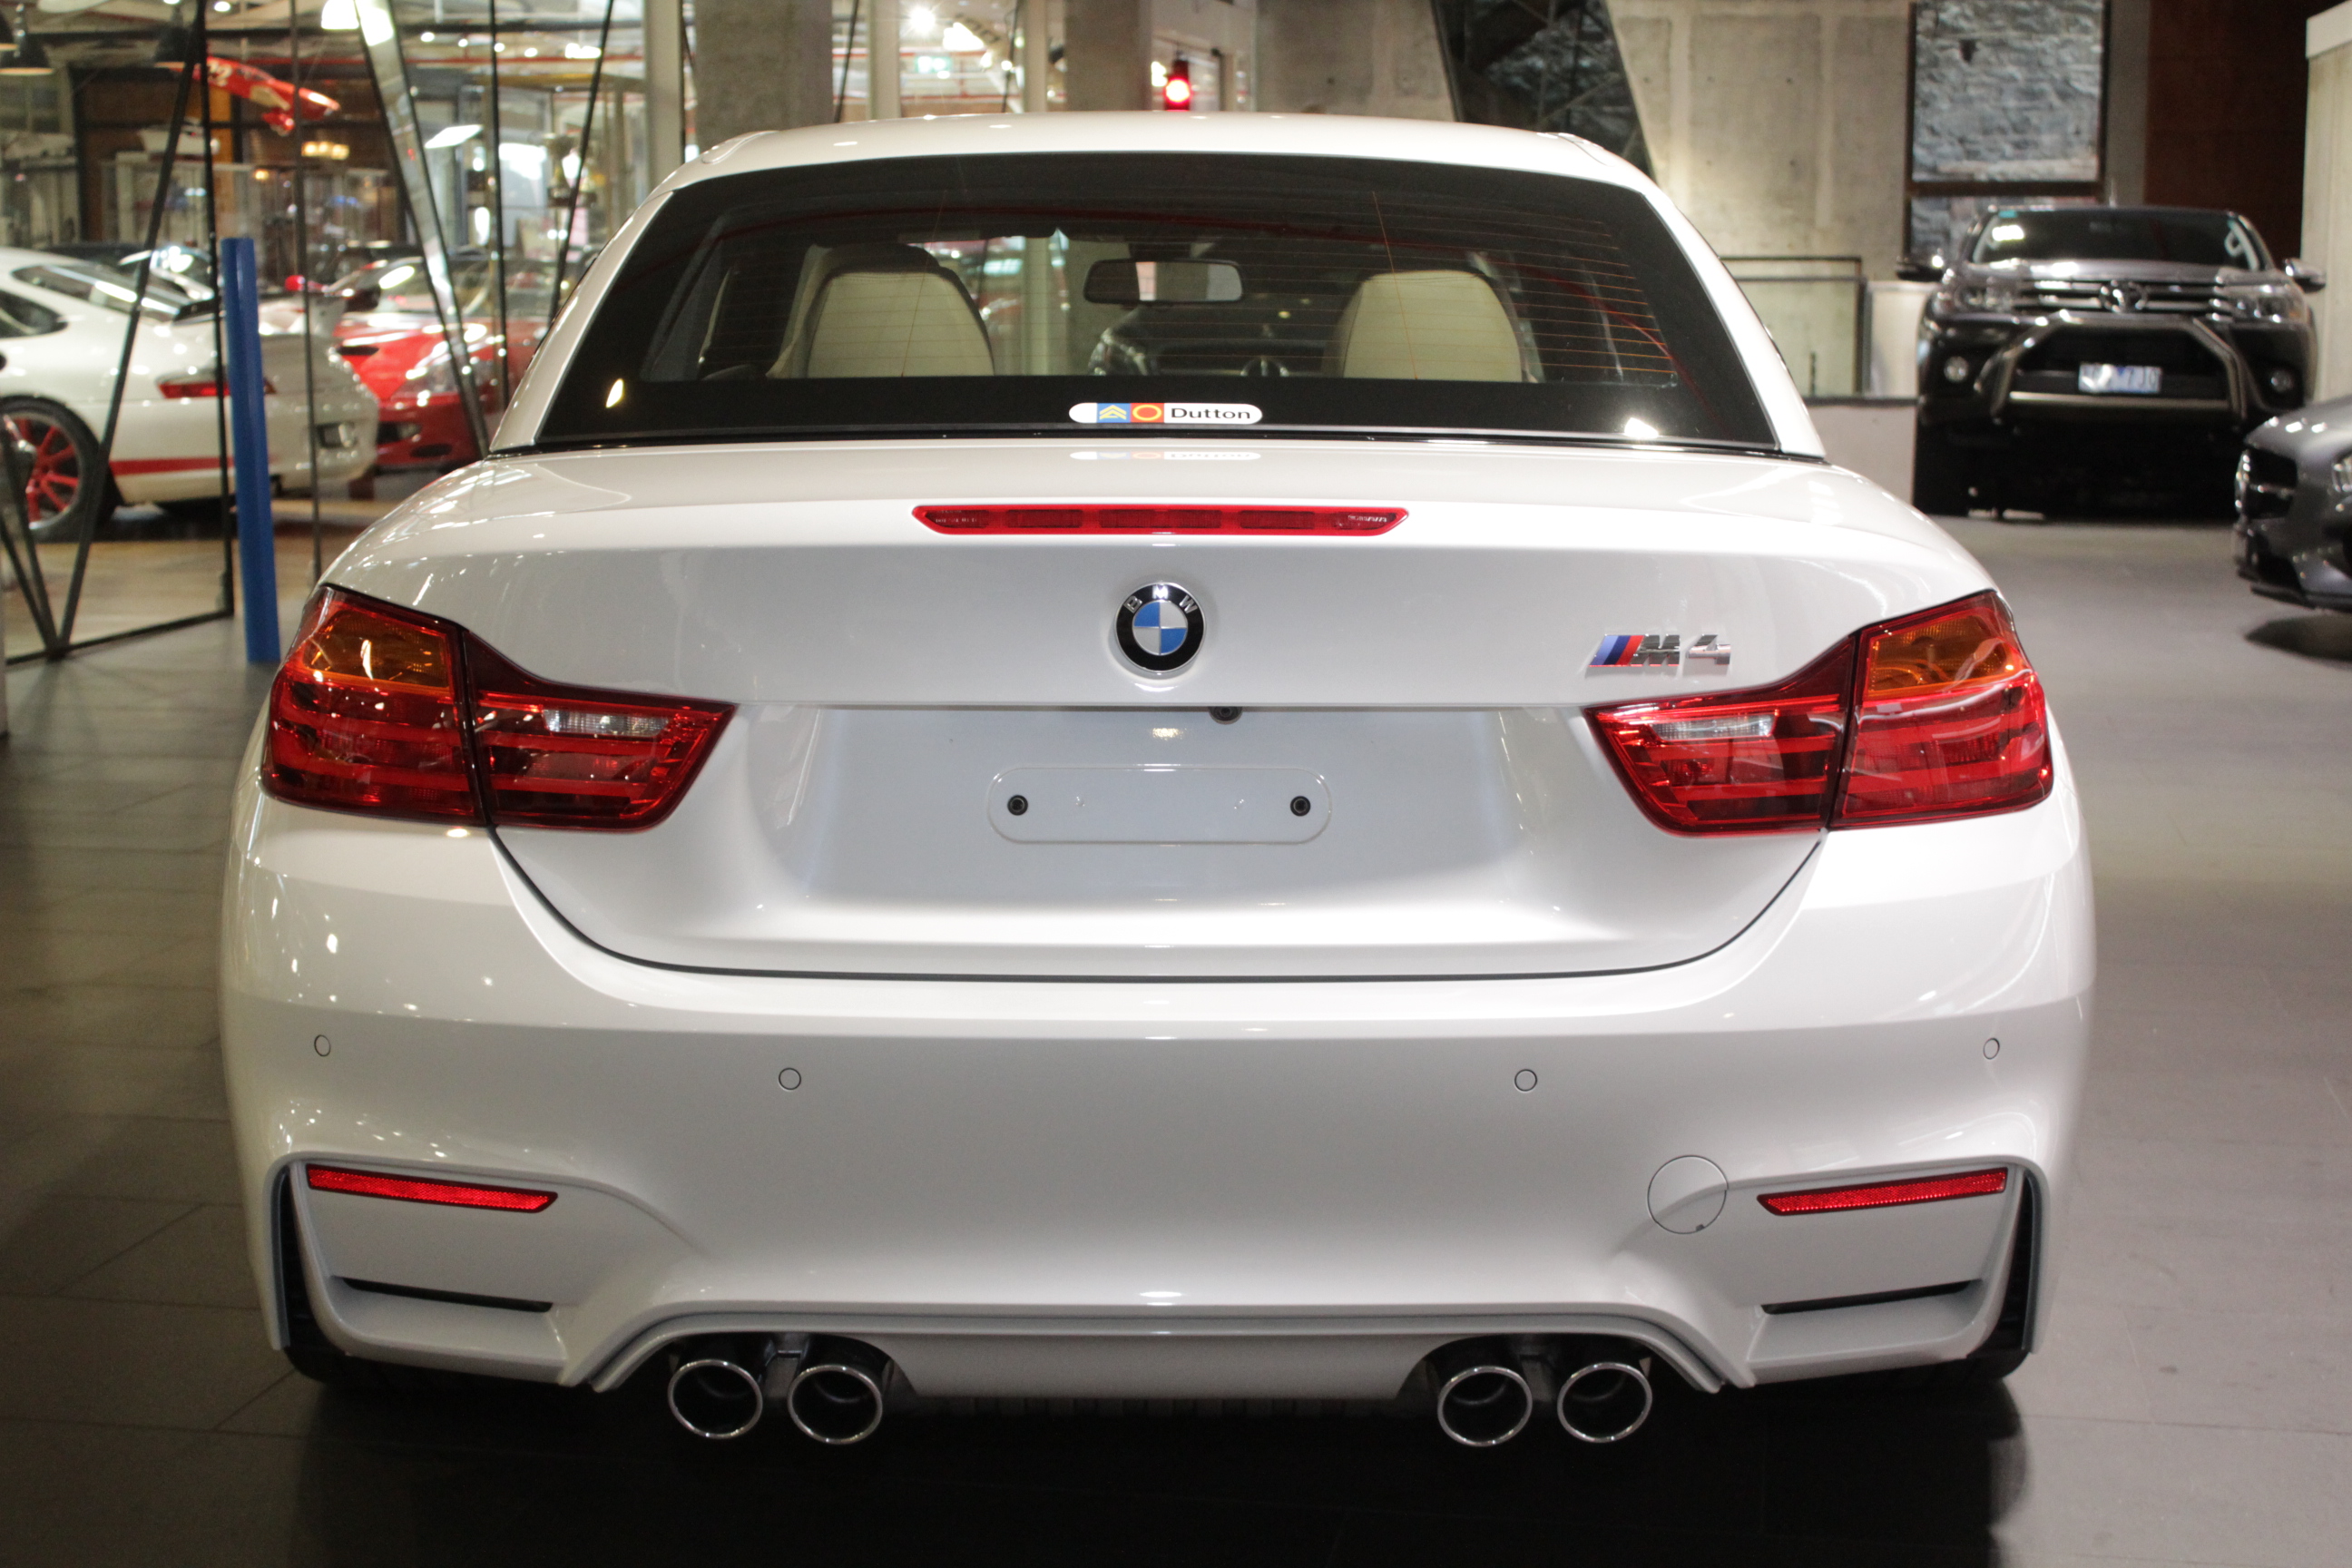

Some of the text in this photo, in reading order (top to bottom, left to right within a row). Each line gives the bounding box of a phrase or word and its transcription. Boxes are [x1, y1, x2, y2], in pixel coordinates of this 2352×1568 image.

[1171, 407, 1251, 419] Dutton
[1122, 583, 1199, 615] BMW
[1628, 634, 1731, 667] M4
